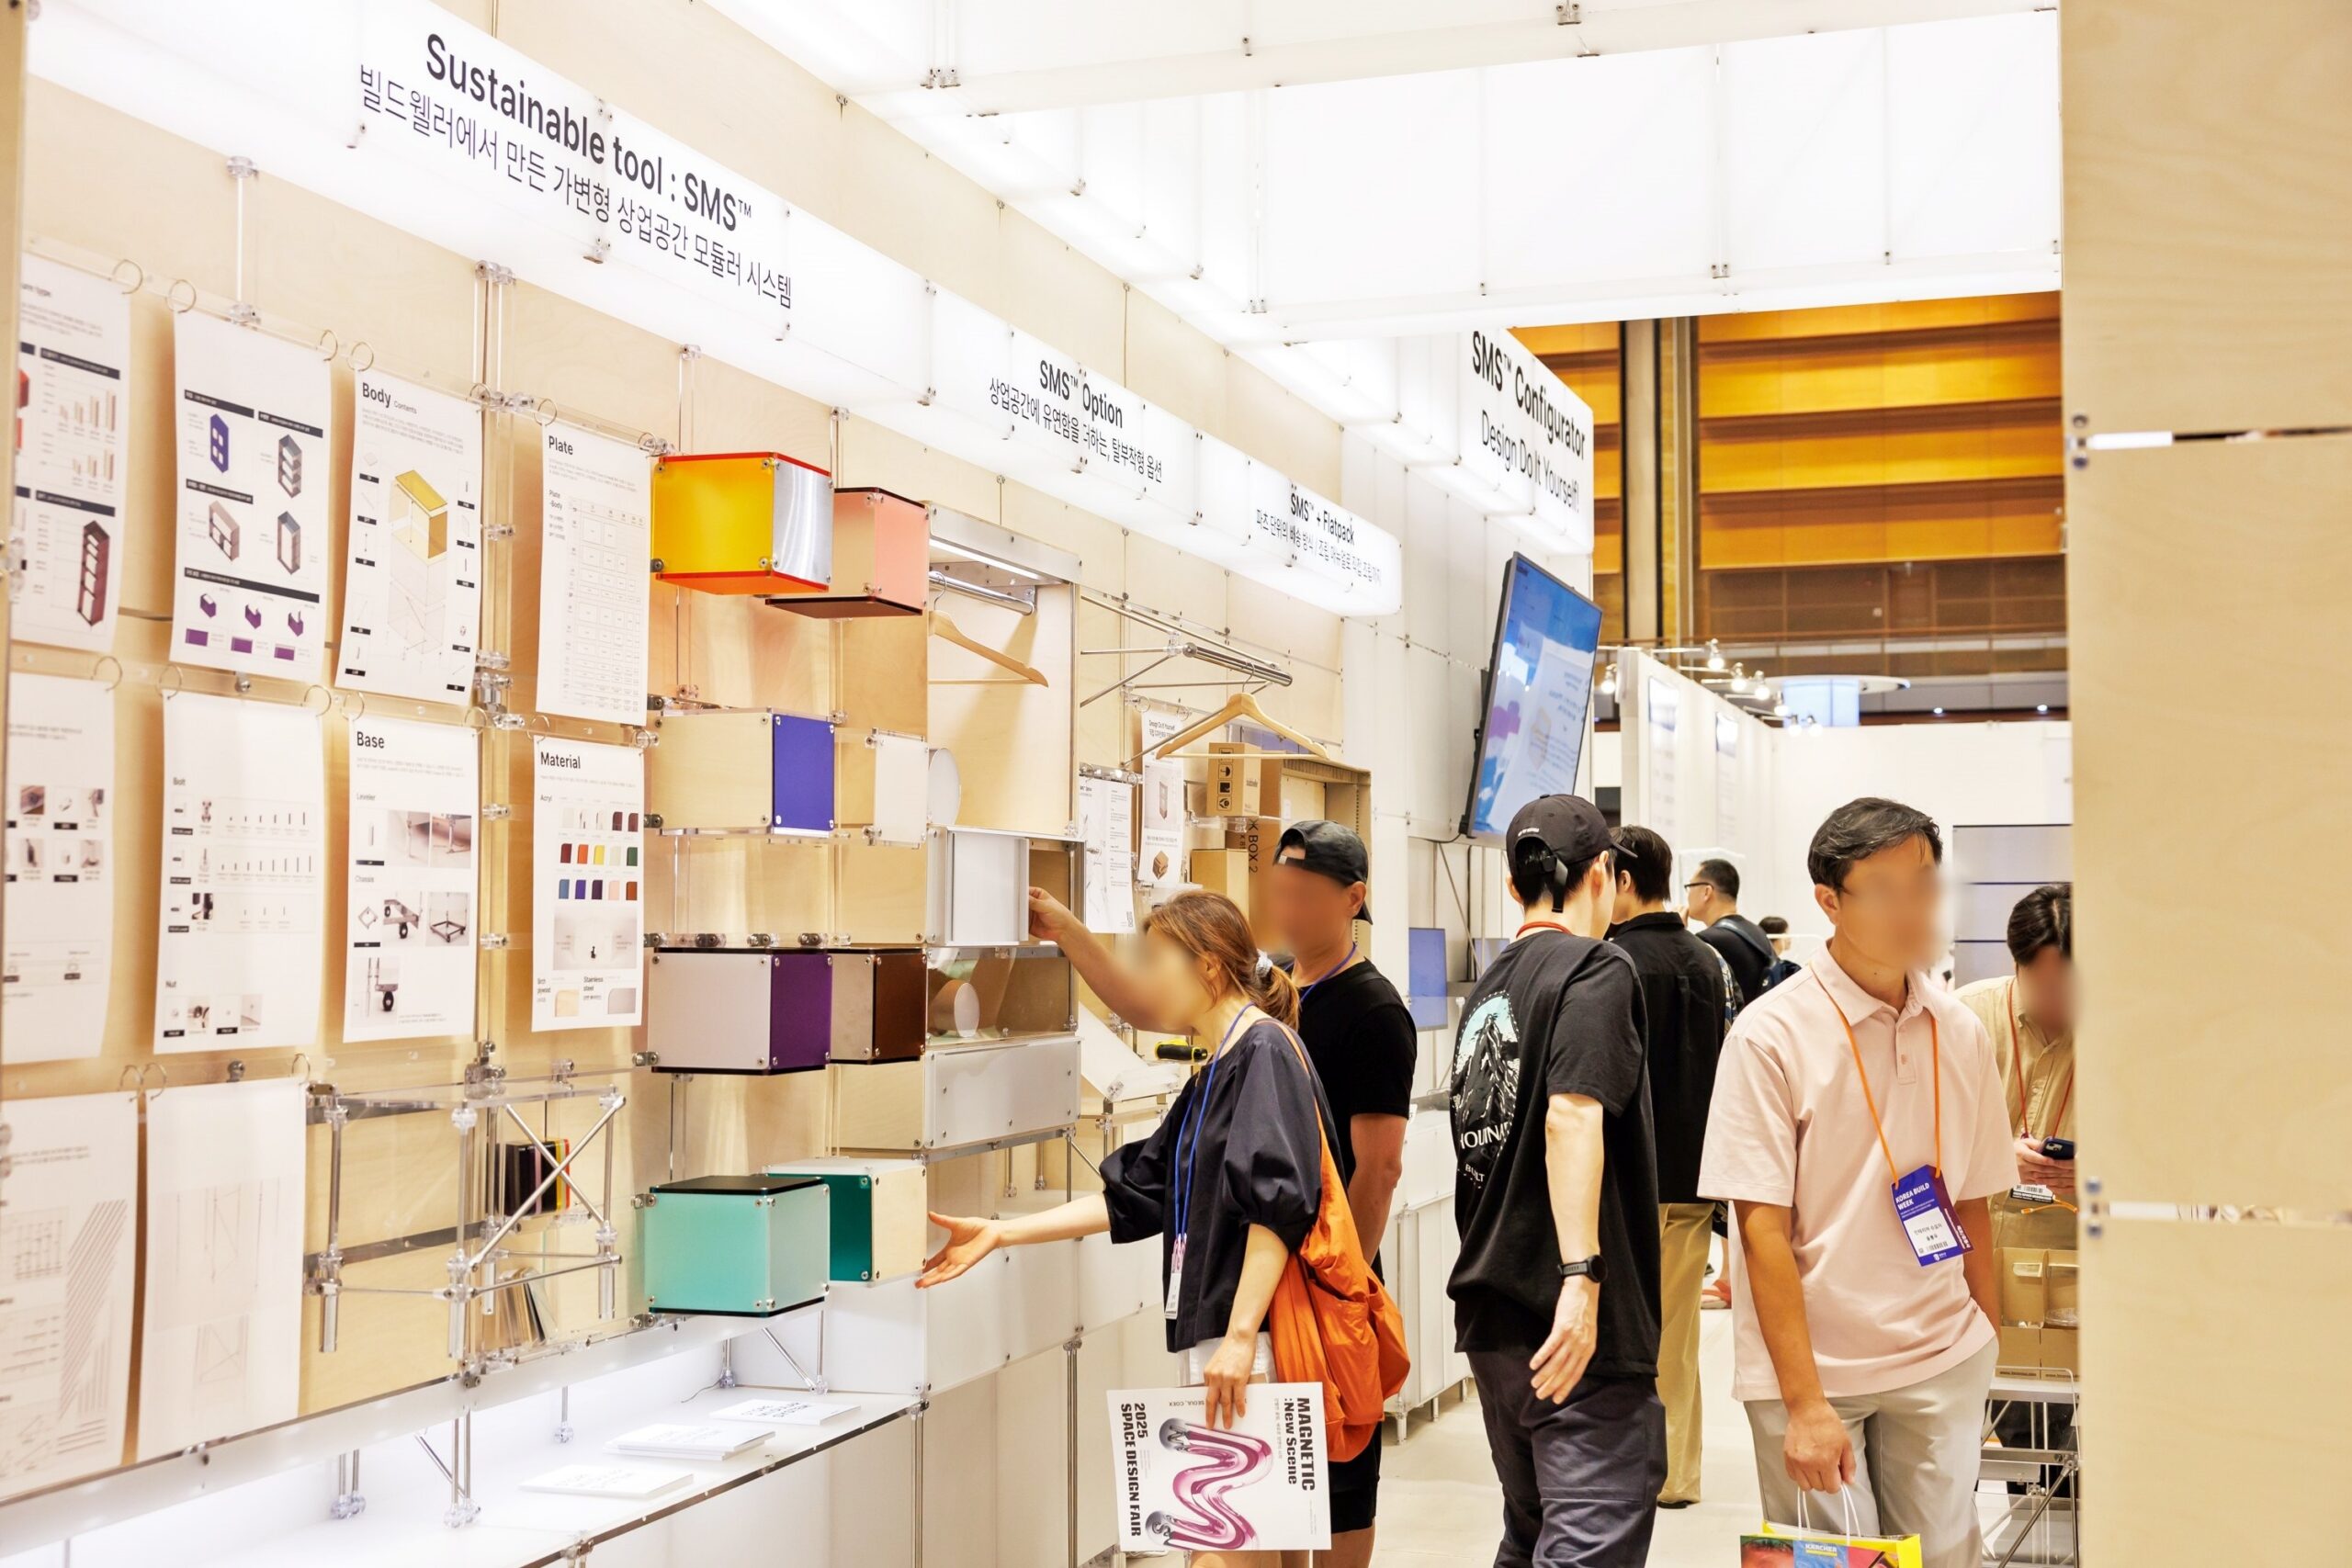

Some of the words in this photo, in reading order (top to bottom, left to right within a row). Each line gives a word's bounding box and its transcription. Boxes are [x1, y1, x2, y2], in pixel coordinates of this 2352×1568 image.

[426, 33, 605, 164] Sustainable
[613, 136, 662, 196] tool
[670, 173, 676, 203] :
[360, 63, 498, 172] 빌드웰러에서
[505, 140, 547, 194] 만든
[553, 165, 612, 224] 가변형
[616, 195, 688, 262] 상업공간
[694, 234, 742, 288] 모듈러
[747, 260, 793, 310] 시스템
[362, 381, 391, 409] Body
[1082, 382, 1124, 429] Option
[1515, 365, 1586, 461] Configurator
[548, 434, 574, 457] Plate
[989, 377, 1041, 425] 상업공간에
[1043, 403, 1080, 445] 유연함을
[1146, 455, 1163, 484] 옵션
[1482, 409, 1517, 472] Design
[1520, 438, 1533, 479] Do
[1535, 450, 1542, 486] It
[1323, 510, 1356, 547] Flatpack
[356, 730, 386, 750] Base
[540, 750, 582, 770] Material
[1248, 834, 1259, 862] BOX
[1895, 1190, 1914, 1203] KOREA
[1913, 1182, 1929, 1195] BUILD
[1897, 1198, 1915, 1211] WEEK
[1121, 1403, 1136, 1448] SPACE
[1134, 1403, 1148, 1439] 2025
[1286, 1437, 1297, 1485] Scene
[1296, 1397, 1316, 1491] MAGNETIC
[1125, 1450, 1140, 1502] DESIGN
[1130, 1505, 1142, 1537] FAIR
